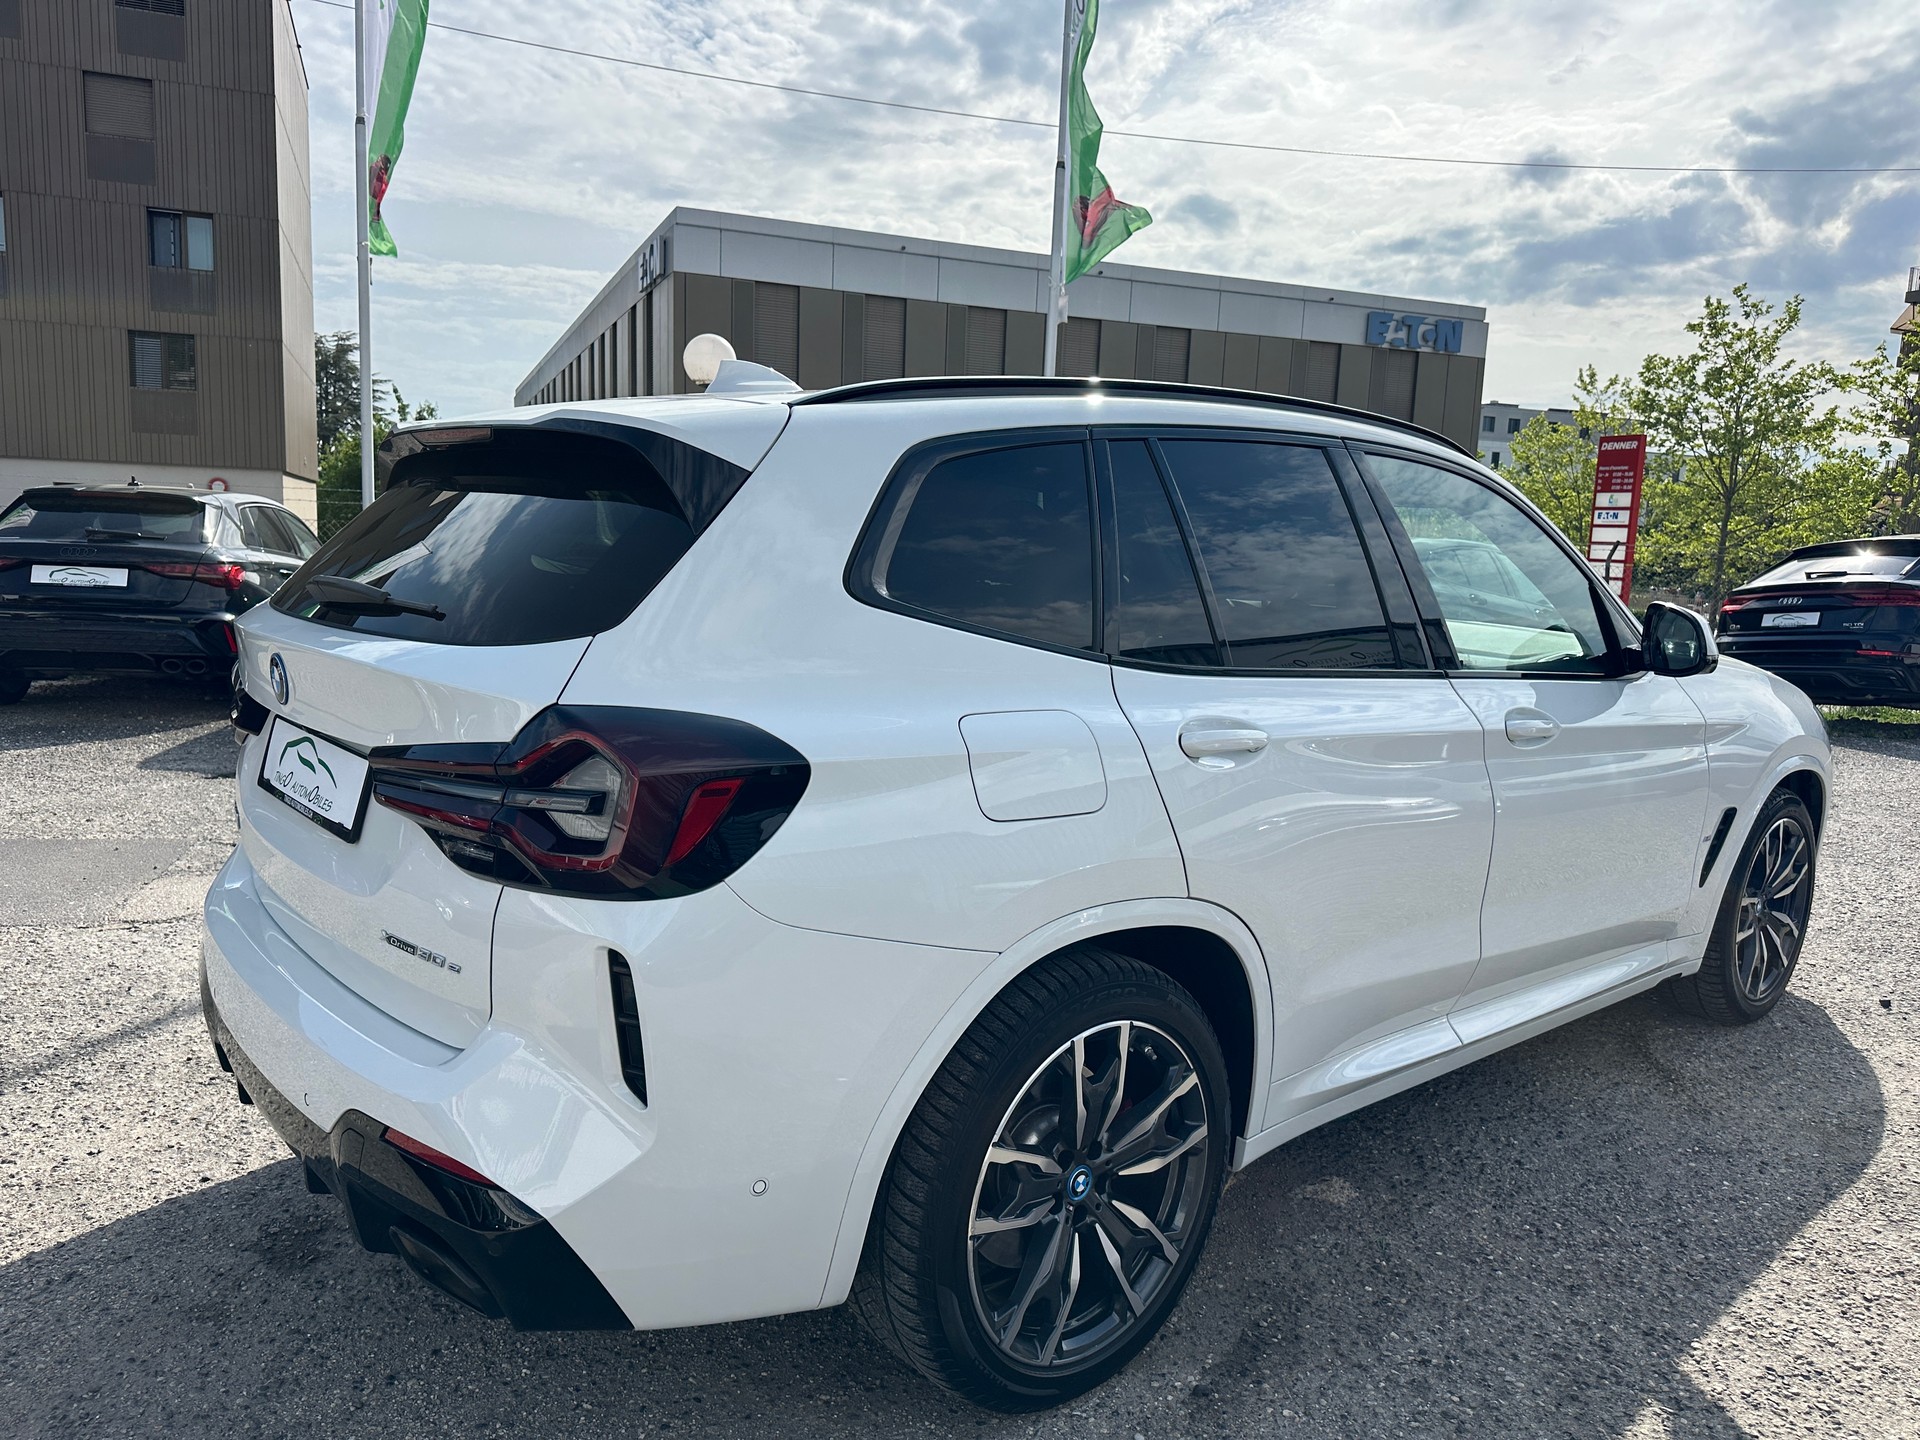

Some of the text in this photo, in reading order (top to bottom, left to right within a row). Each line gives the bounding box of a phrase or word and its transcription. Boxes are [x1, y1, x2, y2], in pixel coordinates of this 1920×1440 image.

[1366, 311, 1463, 353] EATON
[1601, 441, 1638, 450] DENNER
[274, 771, 294, 788] TINGO
[290, 781, 333, 813] AUTOMOBILES
